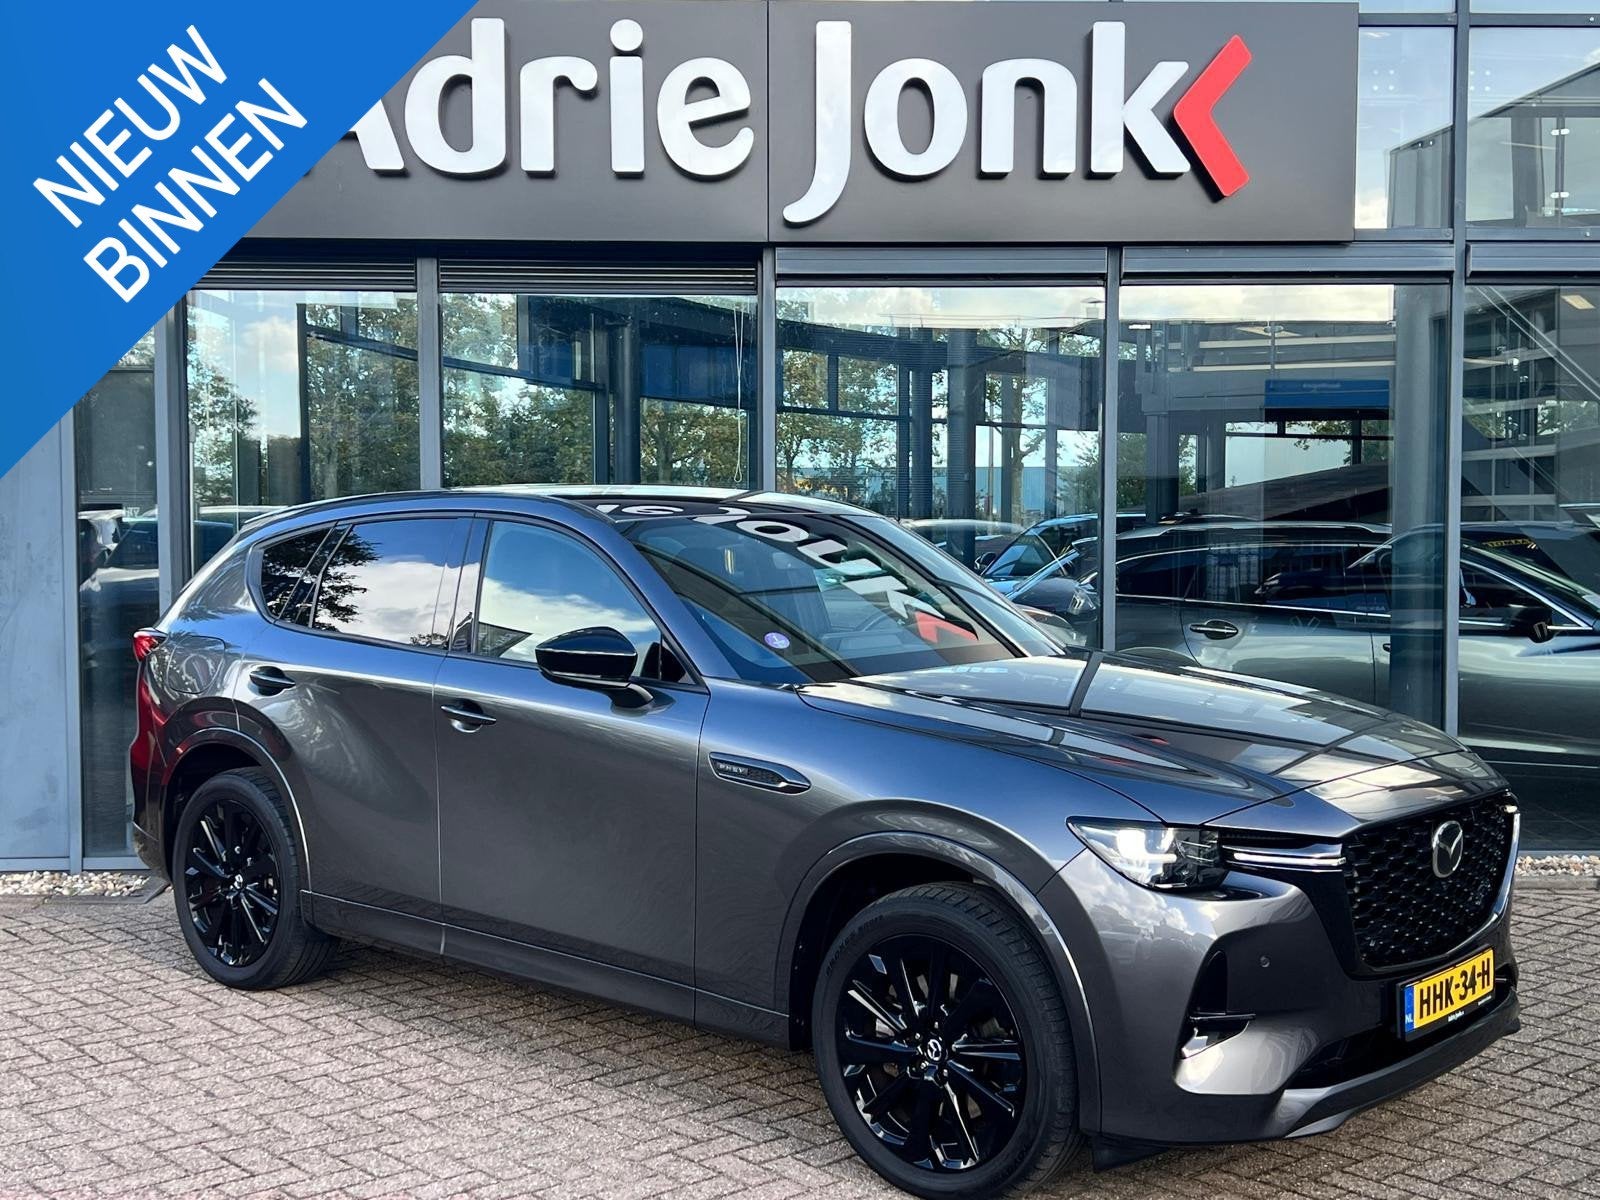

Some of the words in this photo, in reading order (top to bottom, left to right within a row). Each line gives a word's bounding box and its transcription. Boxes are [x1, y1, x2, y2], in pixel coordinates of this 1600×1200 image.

[782, 20, 1191, 225] Jonk
[1404, 1013, 1414, 1024] NL
[1419, 957, 1491, 1020] HHK-34-H
